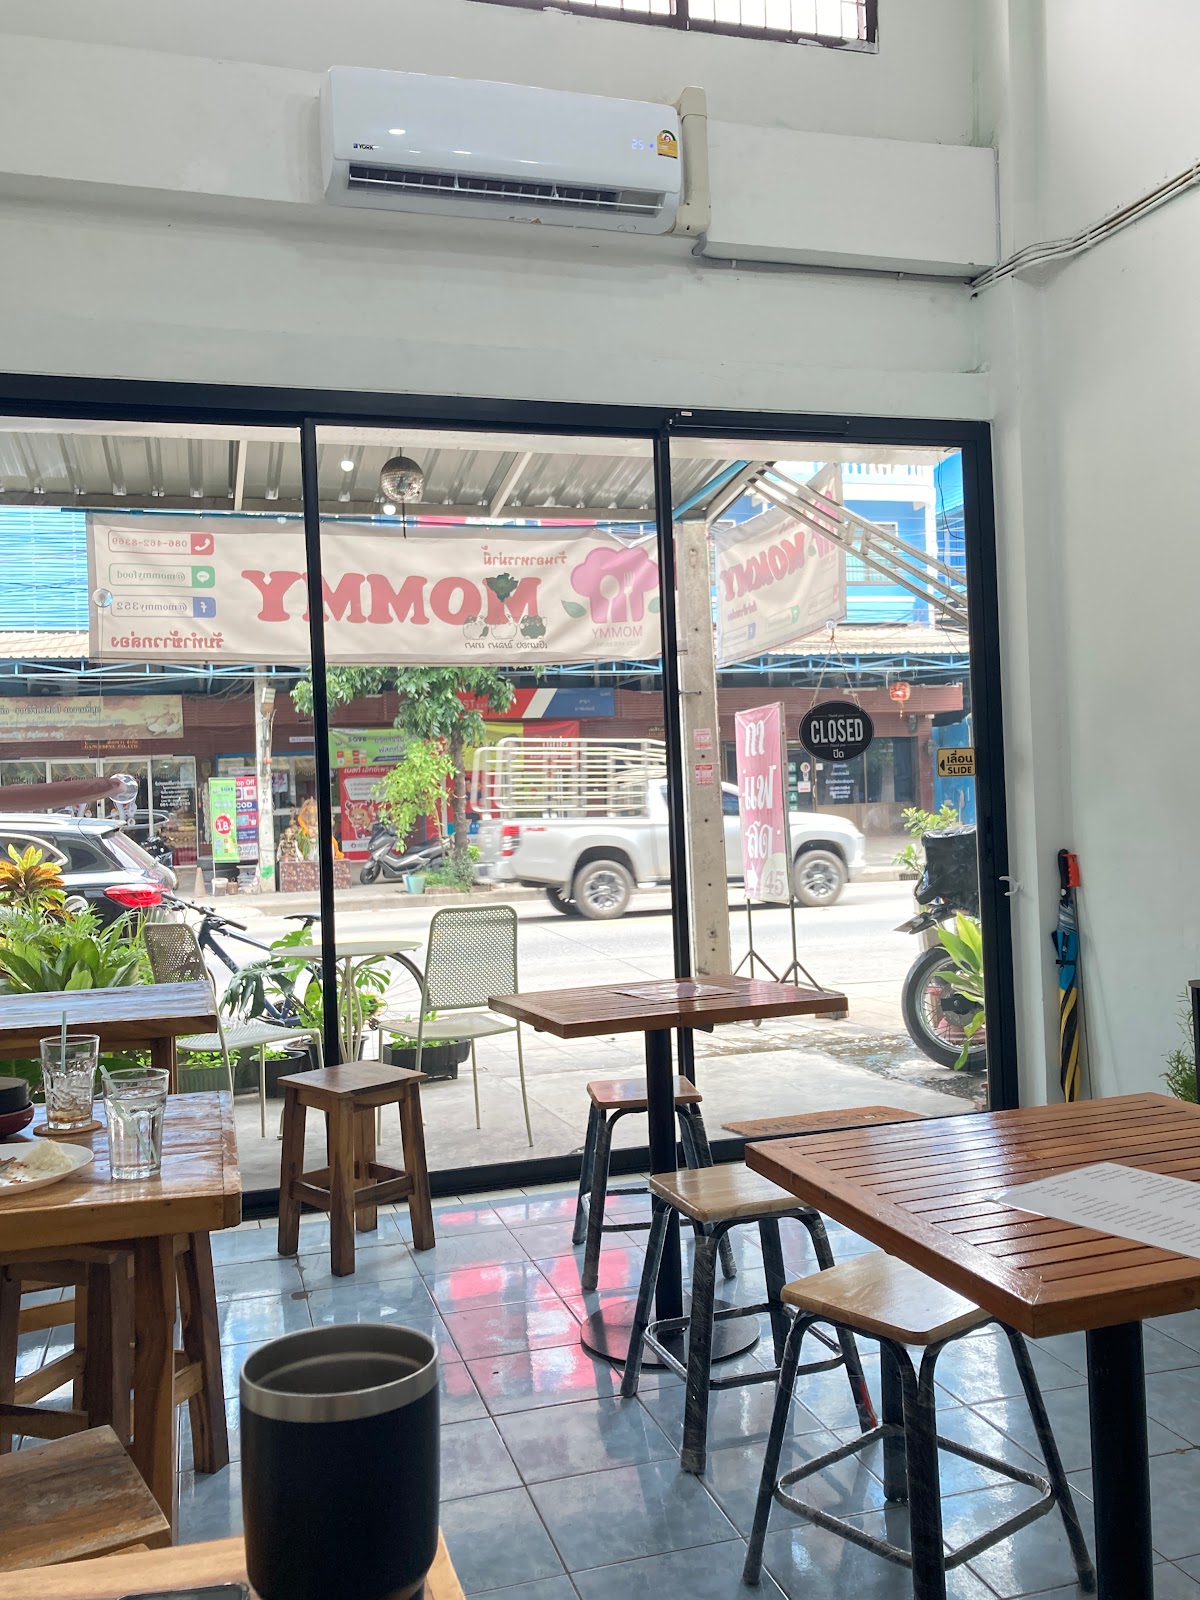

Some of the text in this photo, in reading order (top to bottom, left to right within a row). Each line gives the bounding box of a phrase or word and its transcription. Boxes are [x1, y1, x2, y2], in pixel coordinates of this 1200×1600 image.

[810, 718, 864, 744] CLOSED
[832, 748, 845, 759] ปิด
[947, 749, 973, 764] เลื่อน
[947, 766, 972, 775] SLIDE
[216, 821, 229, 832] 18
[763, 870, 786, 897] 45
